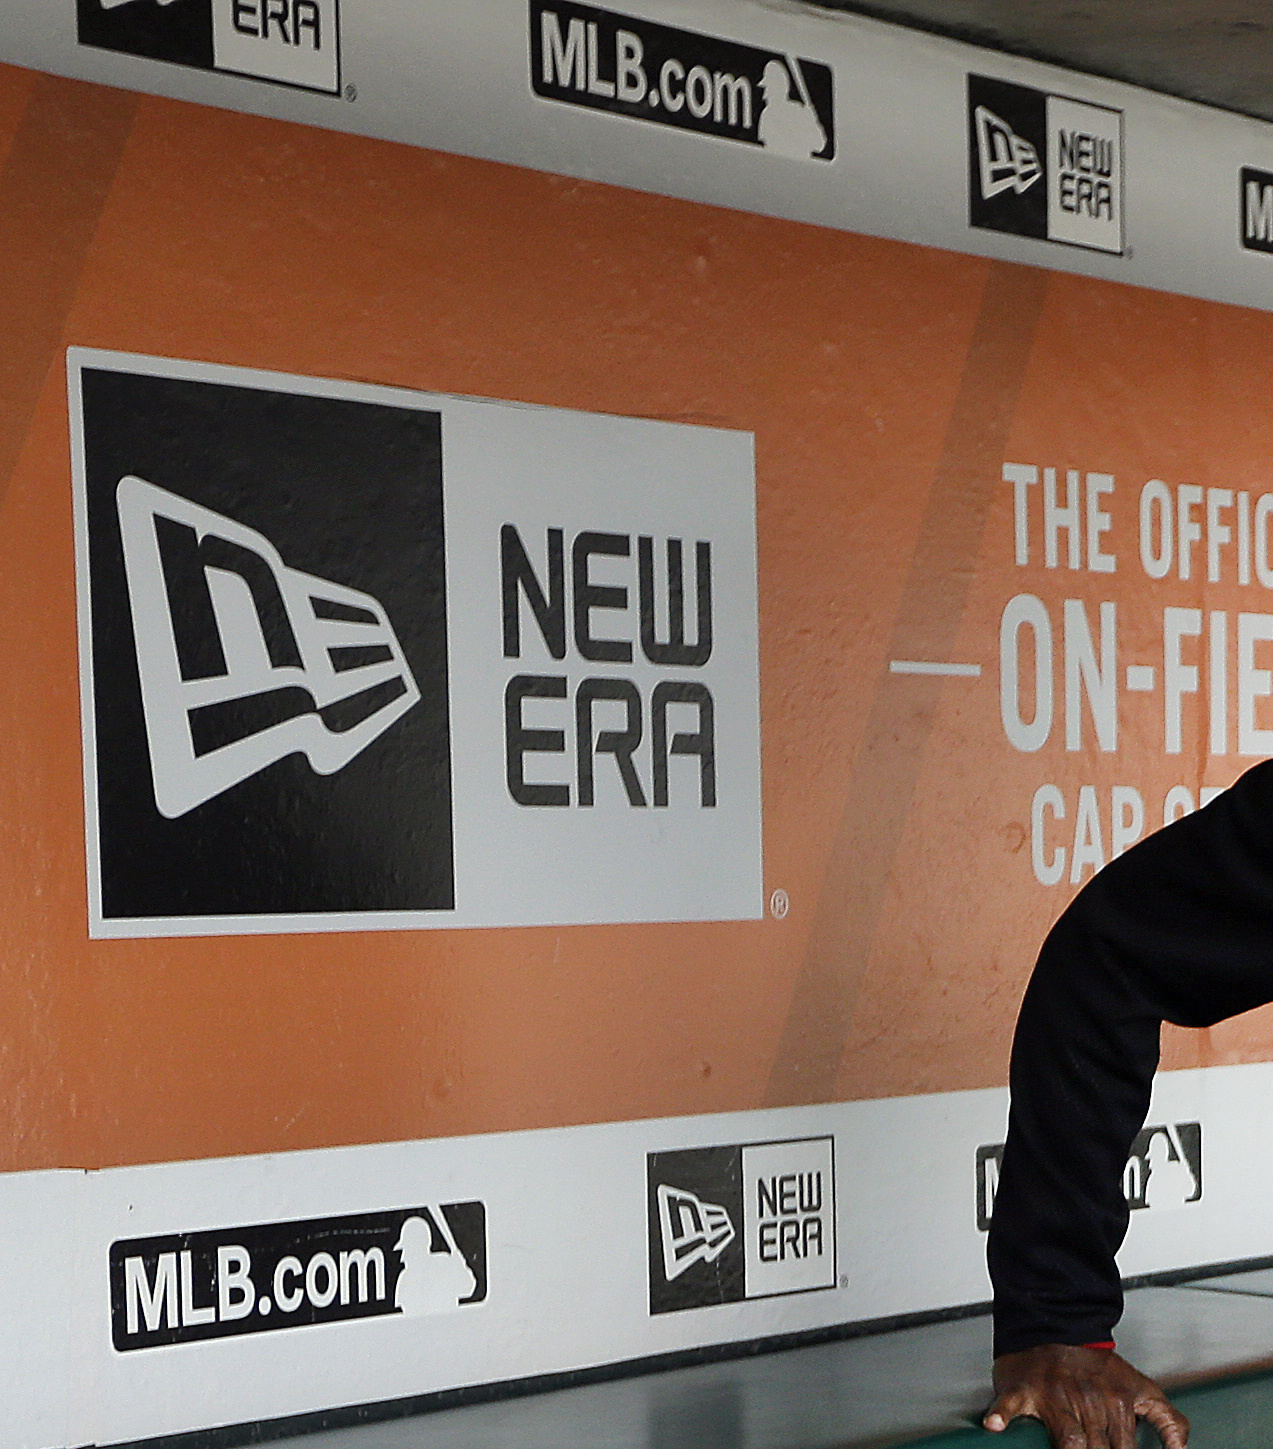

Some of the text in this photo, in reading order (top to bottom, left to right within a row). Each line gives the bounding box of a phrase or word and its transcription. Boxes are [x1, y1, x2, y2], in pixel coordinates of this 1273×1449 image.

[231, 0, 321, 51] ERA
[541, 11, 752, 129] MLB.com
[1058, 128, 1114, 178] NEW
[1058, 173, 1113, 222] ERA
[1002, 461, 1118, 574] THE
[500, 521, 714, 667] NEW
[504, 674, 720, 809] ERA
[1031, 783, 1145, 886] CAP
[756, 1169, 823, 1214] NEW
[758, 1215, 823, 1262] ERA
[123, 1244, 387, 1334] MLB.com
